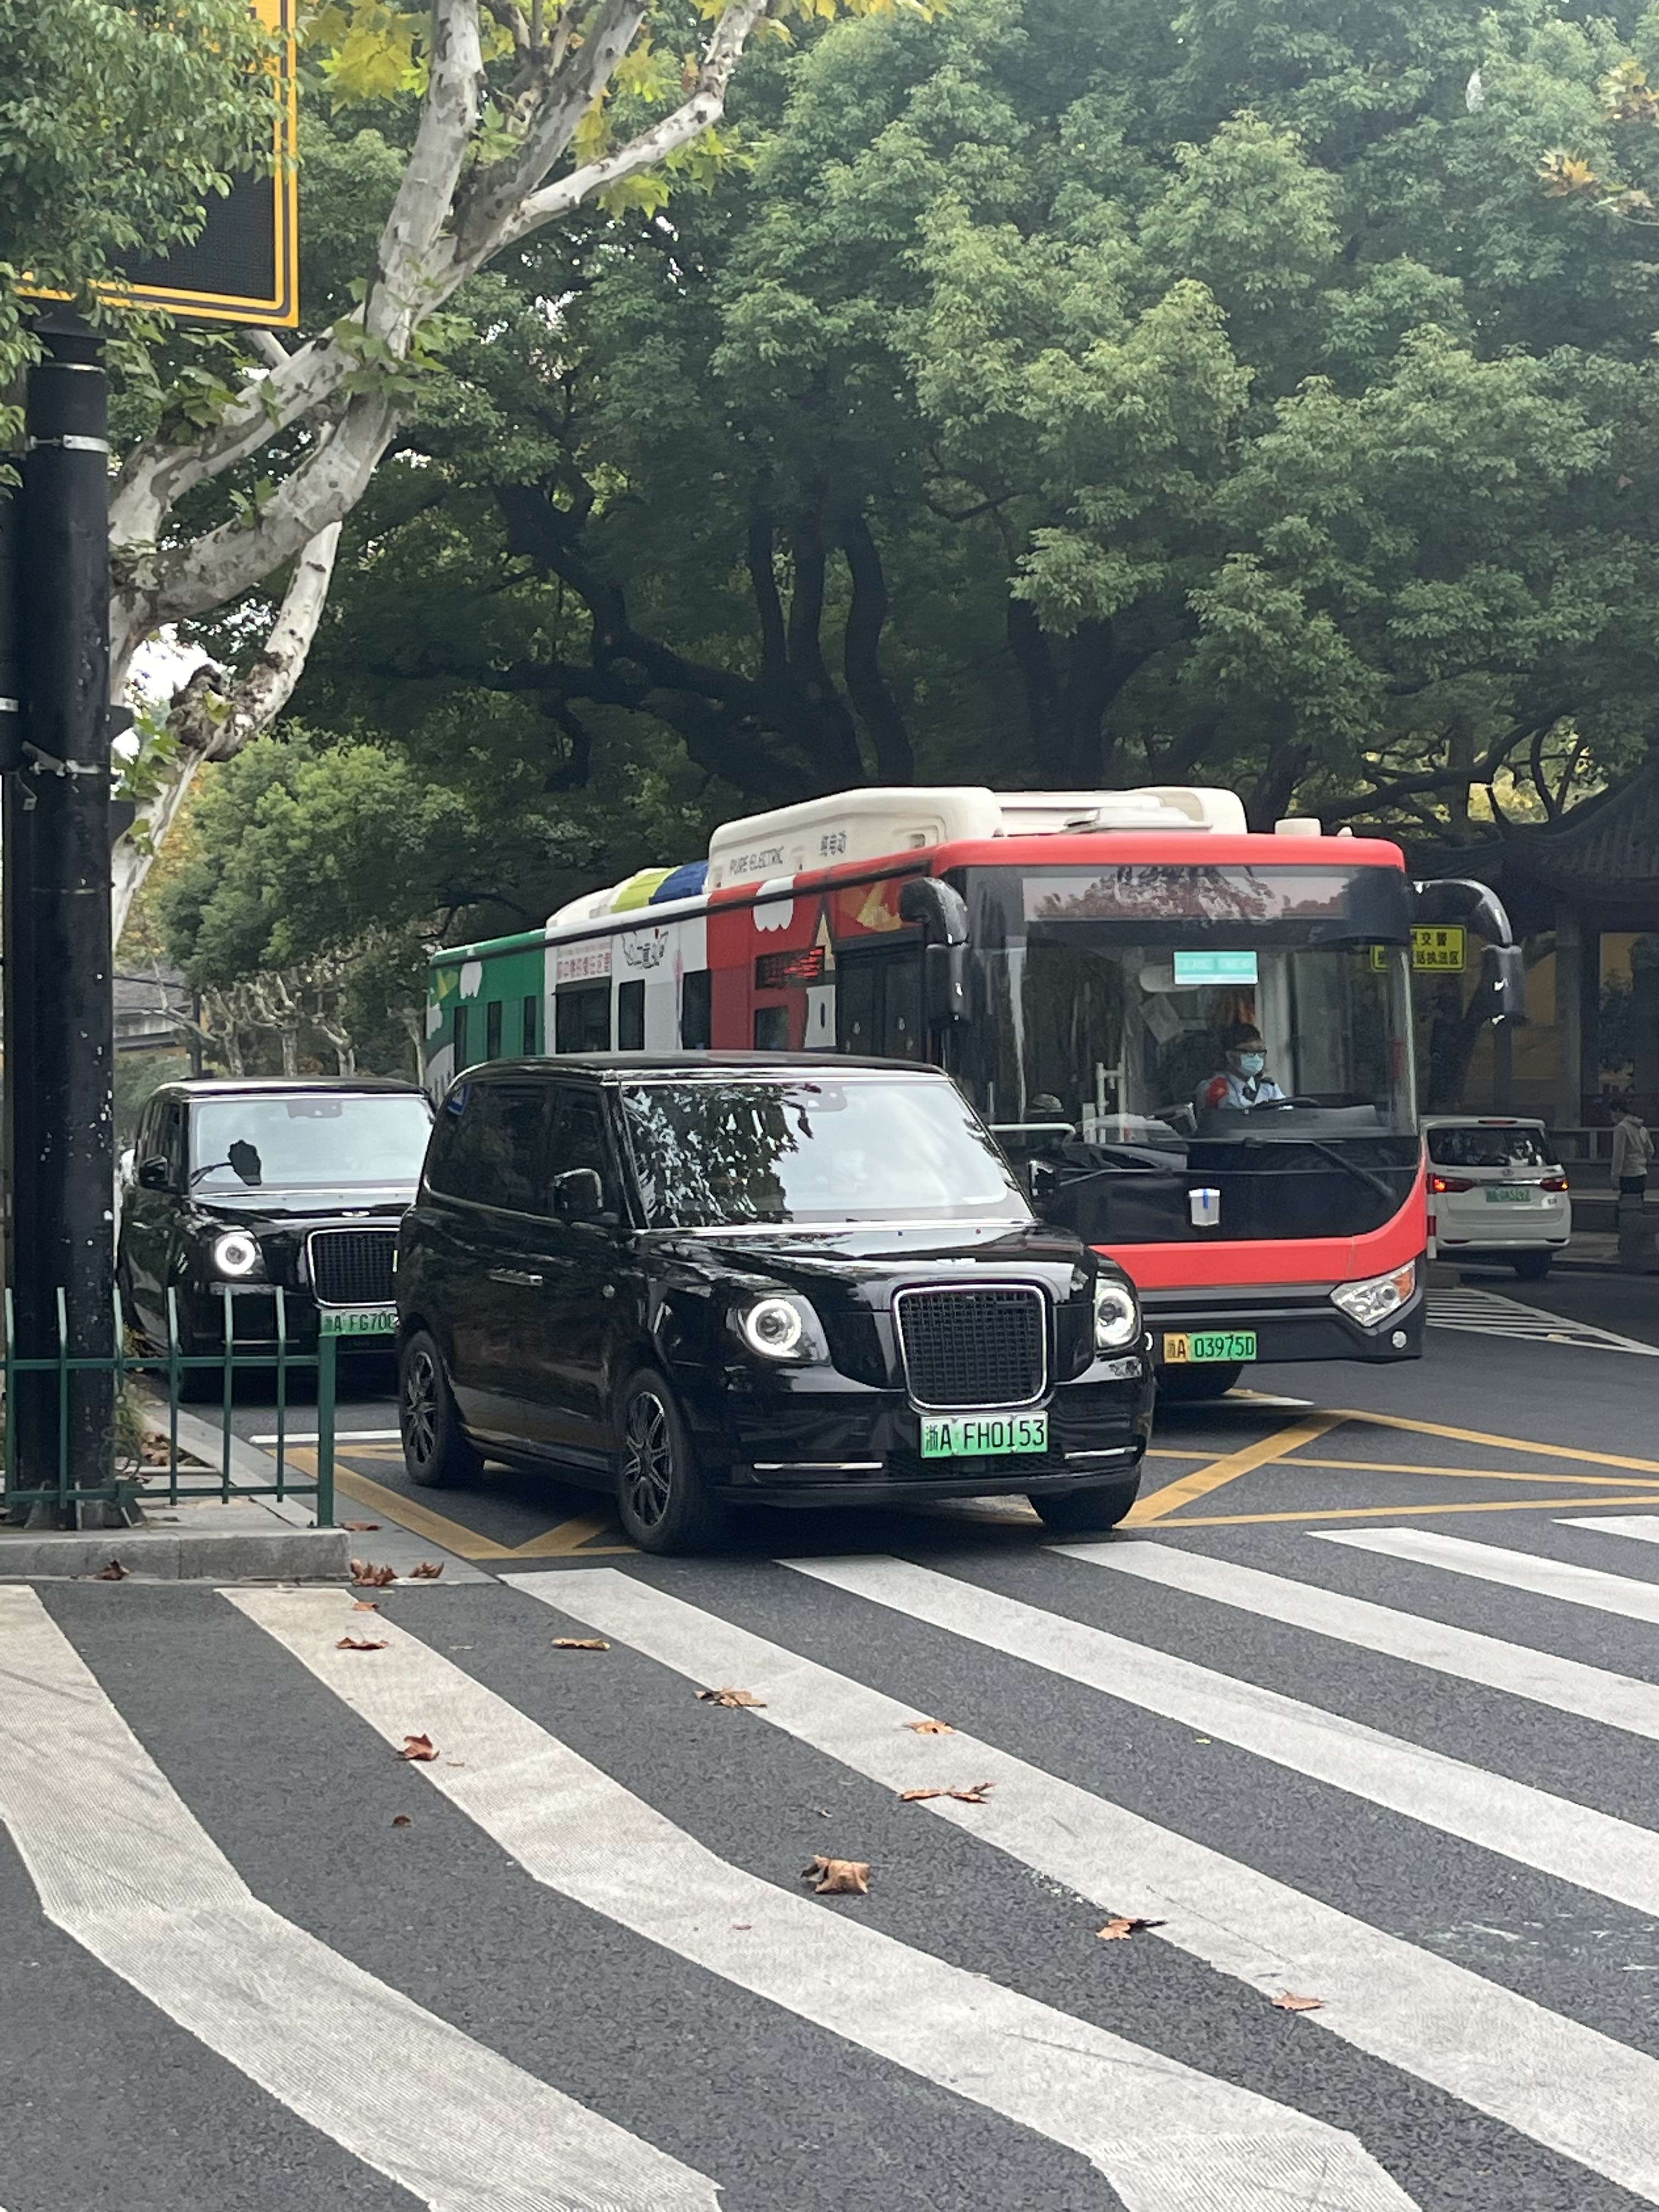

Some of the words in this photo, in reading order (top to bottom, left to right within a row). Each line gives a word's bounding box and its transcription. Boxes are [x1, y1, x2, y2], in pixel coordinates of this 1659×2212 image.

[1194, 1336, 1255, 1357] 03975D
[926, 1424, 952, 1452] 浙A
[963, 1419, 1045, 1449] FH0153
